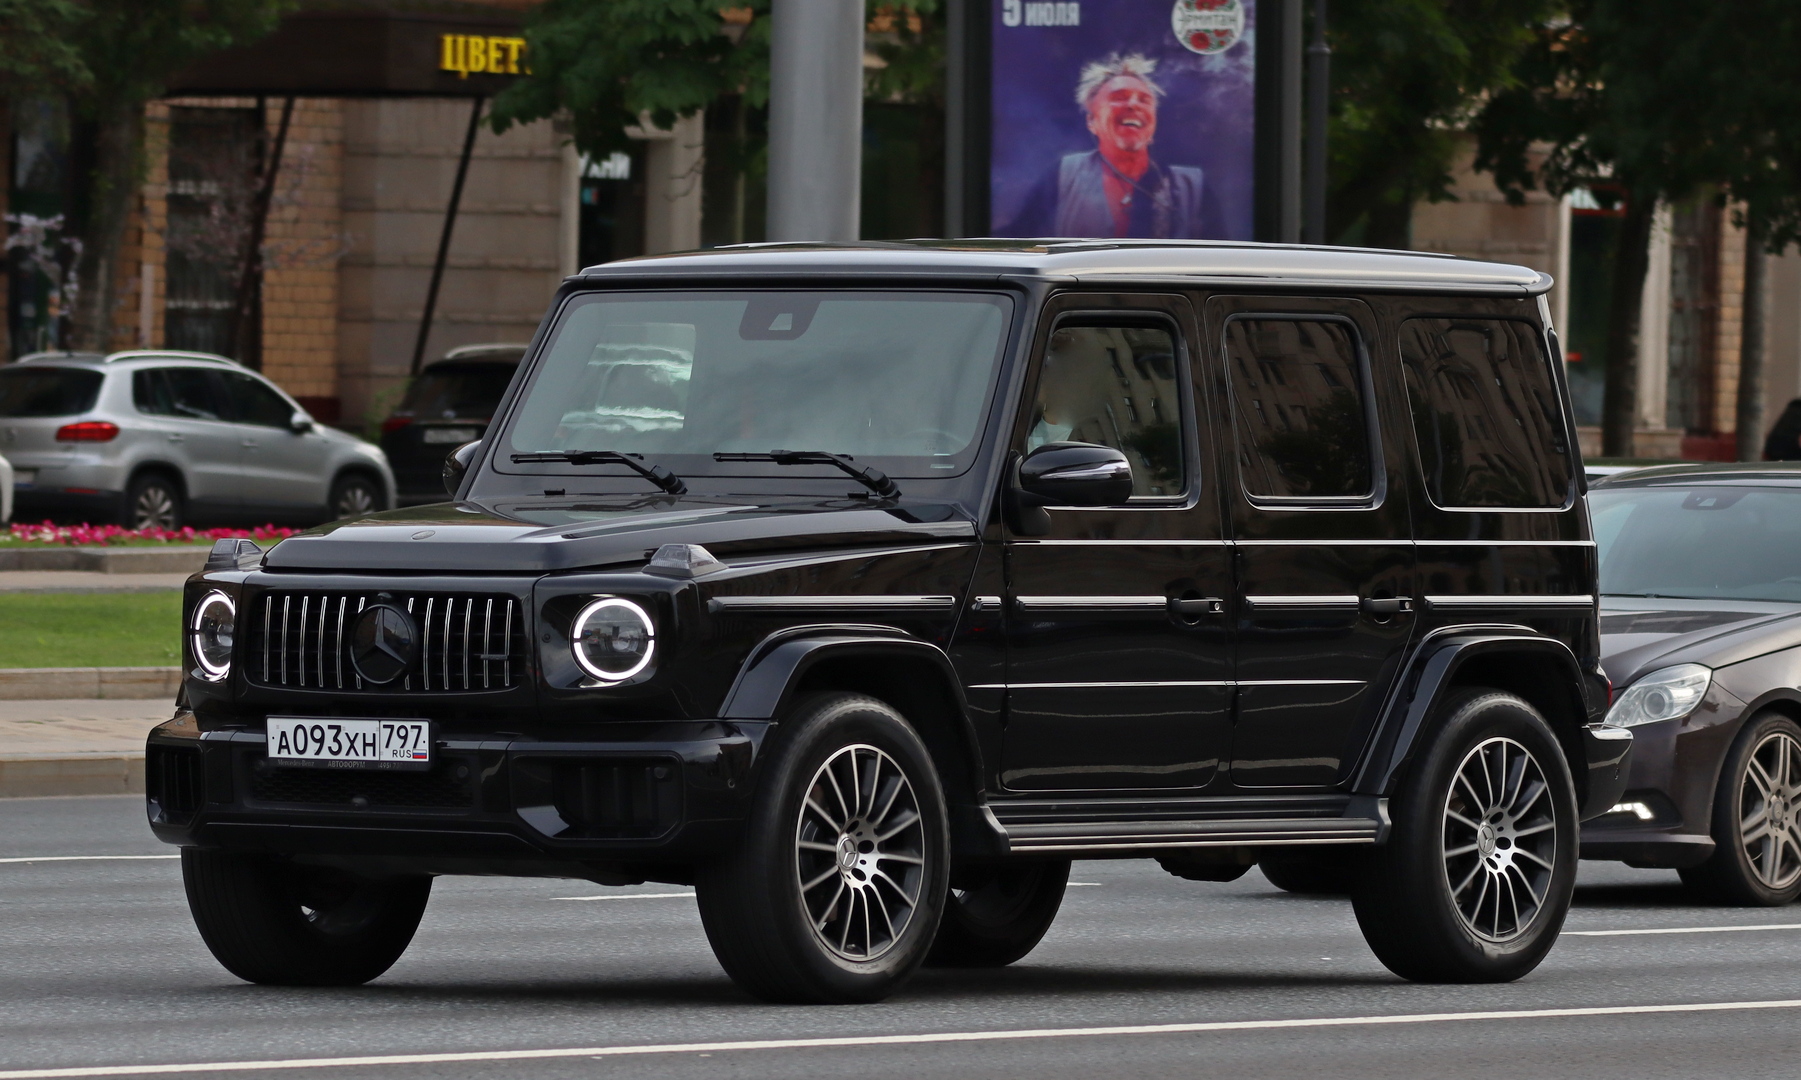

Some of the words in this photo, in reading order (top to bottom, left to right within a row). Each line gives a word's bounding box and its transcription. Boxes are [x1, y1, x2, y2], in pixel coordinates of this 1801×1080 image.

[1002, 0, 1022, 27] 5
[440, 34, 531, 78] ЦВЕТ
[382, 724, 423, 749] 797
[277, 758, 315, 768] Mercedes-Benz
[392, 749, 412, 758] RUS
